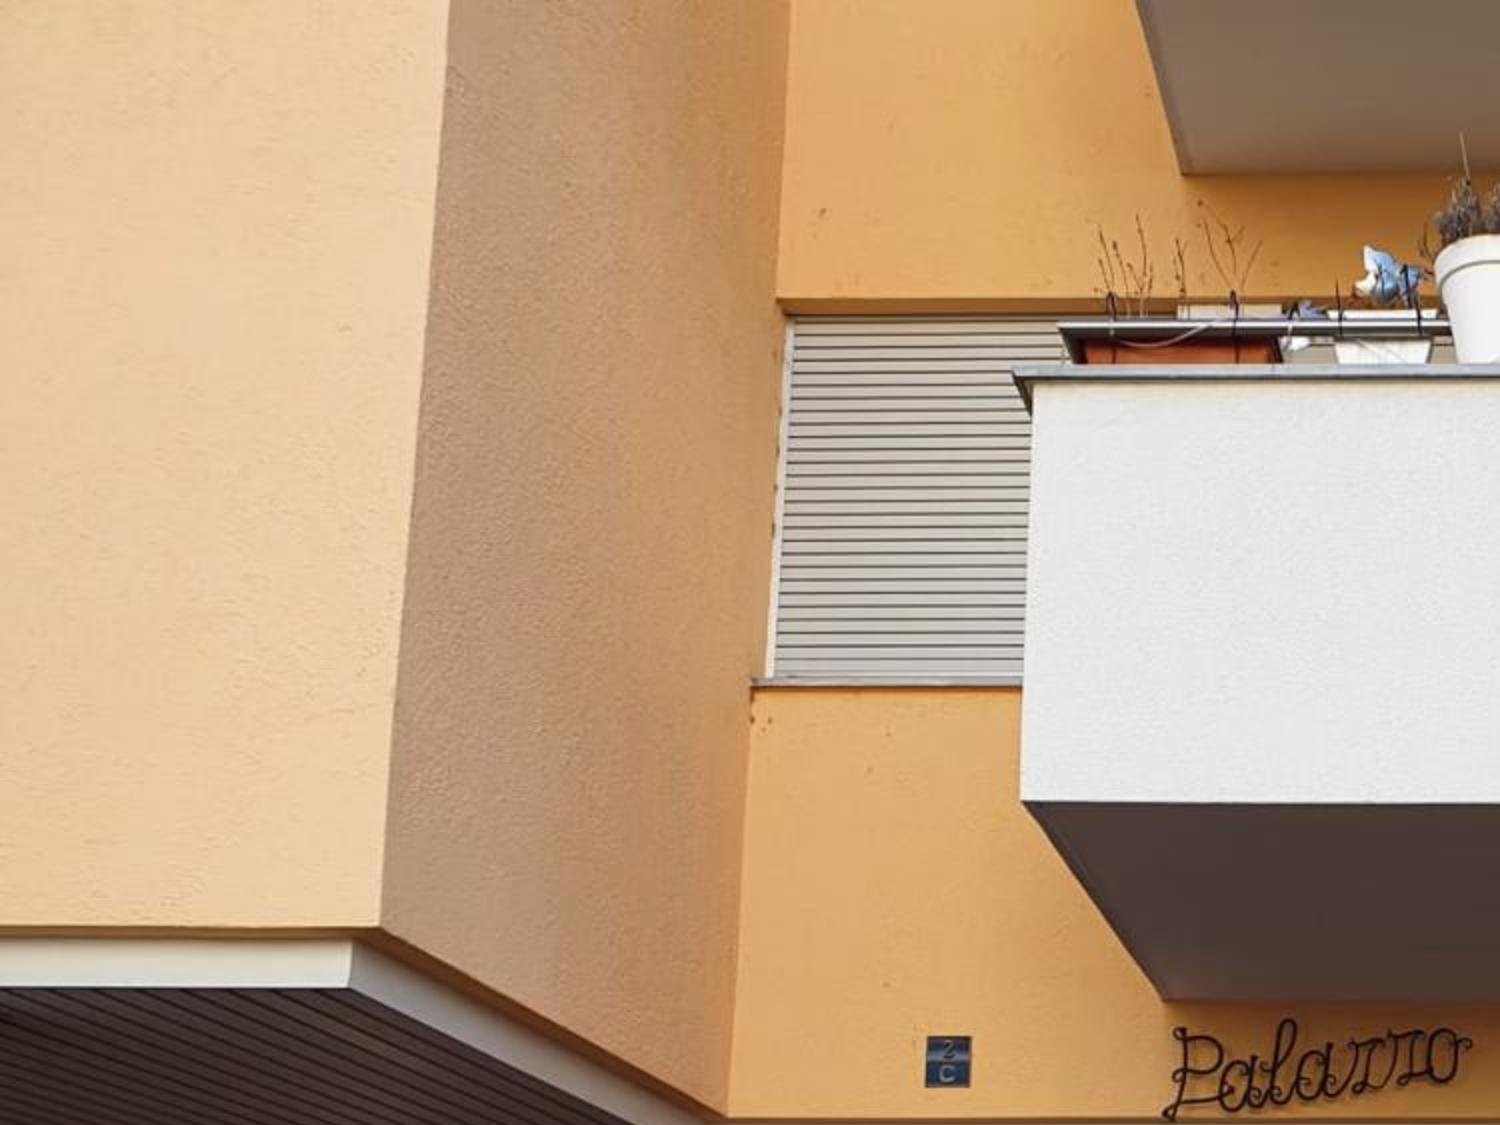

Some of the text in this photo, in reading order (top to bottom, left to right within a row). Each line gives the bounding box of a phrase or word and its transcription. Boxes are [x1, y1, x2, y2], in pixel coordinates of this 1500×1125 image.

[943, 1040, 957, 1059] 2
[940, 1065, 955, 1082] C
[1162, 1018, 1473, 1121] Palazzo
